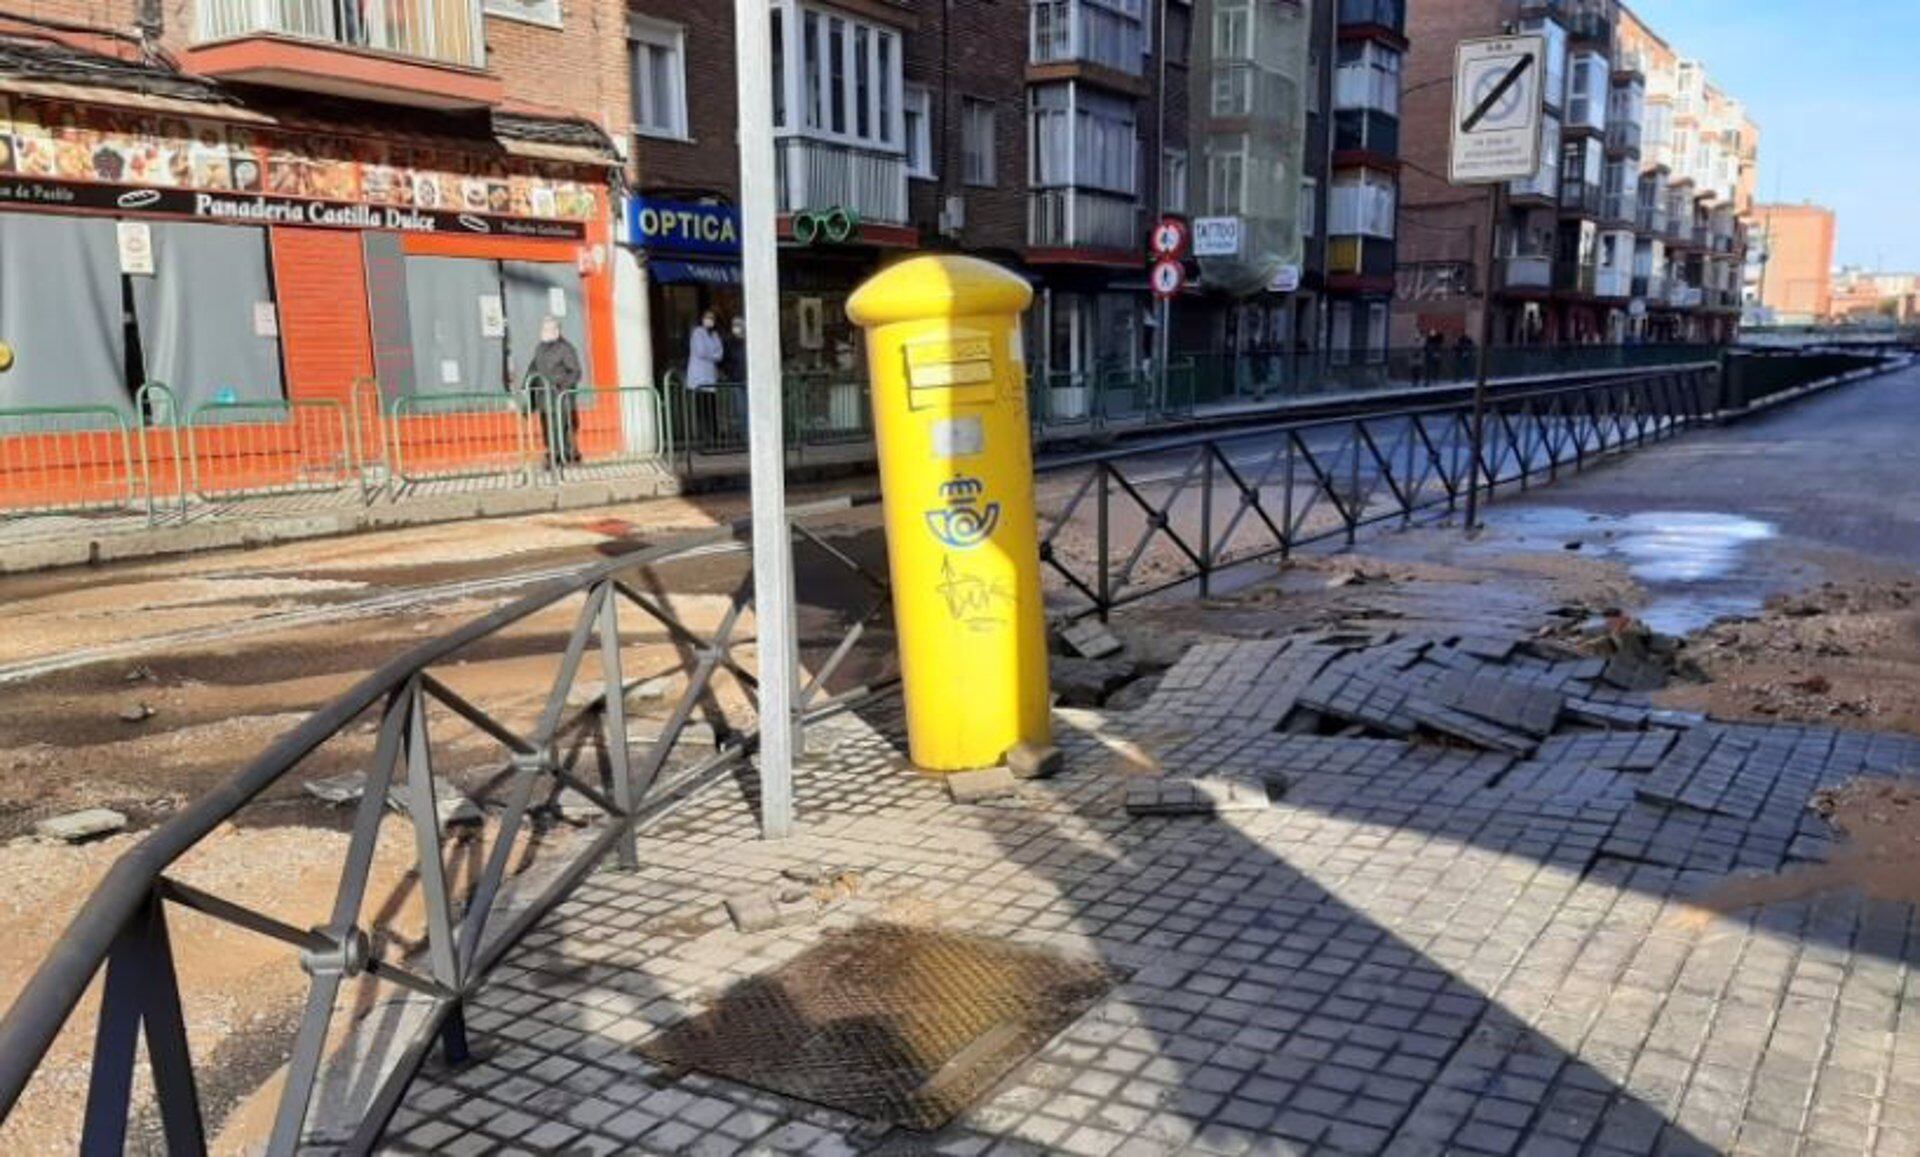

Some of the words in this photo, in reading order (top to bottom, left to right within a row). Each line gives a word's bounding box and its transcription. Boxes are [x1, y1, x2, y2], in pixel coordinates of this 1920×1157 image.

[309, 202, 381, 227] Castilla
[387, 209, 436, 231] Dulce
[639, 208, 736, 242] OPTICA
